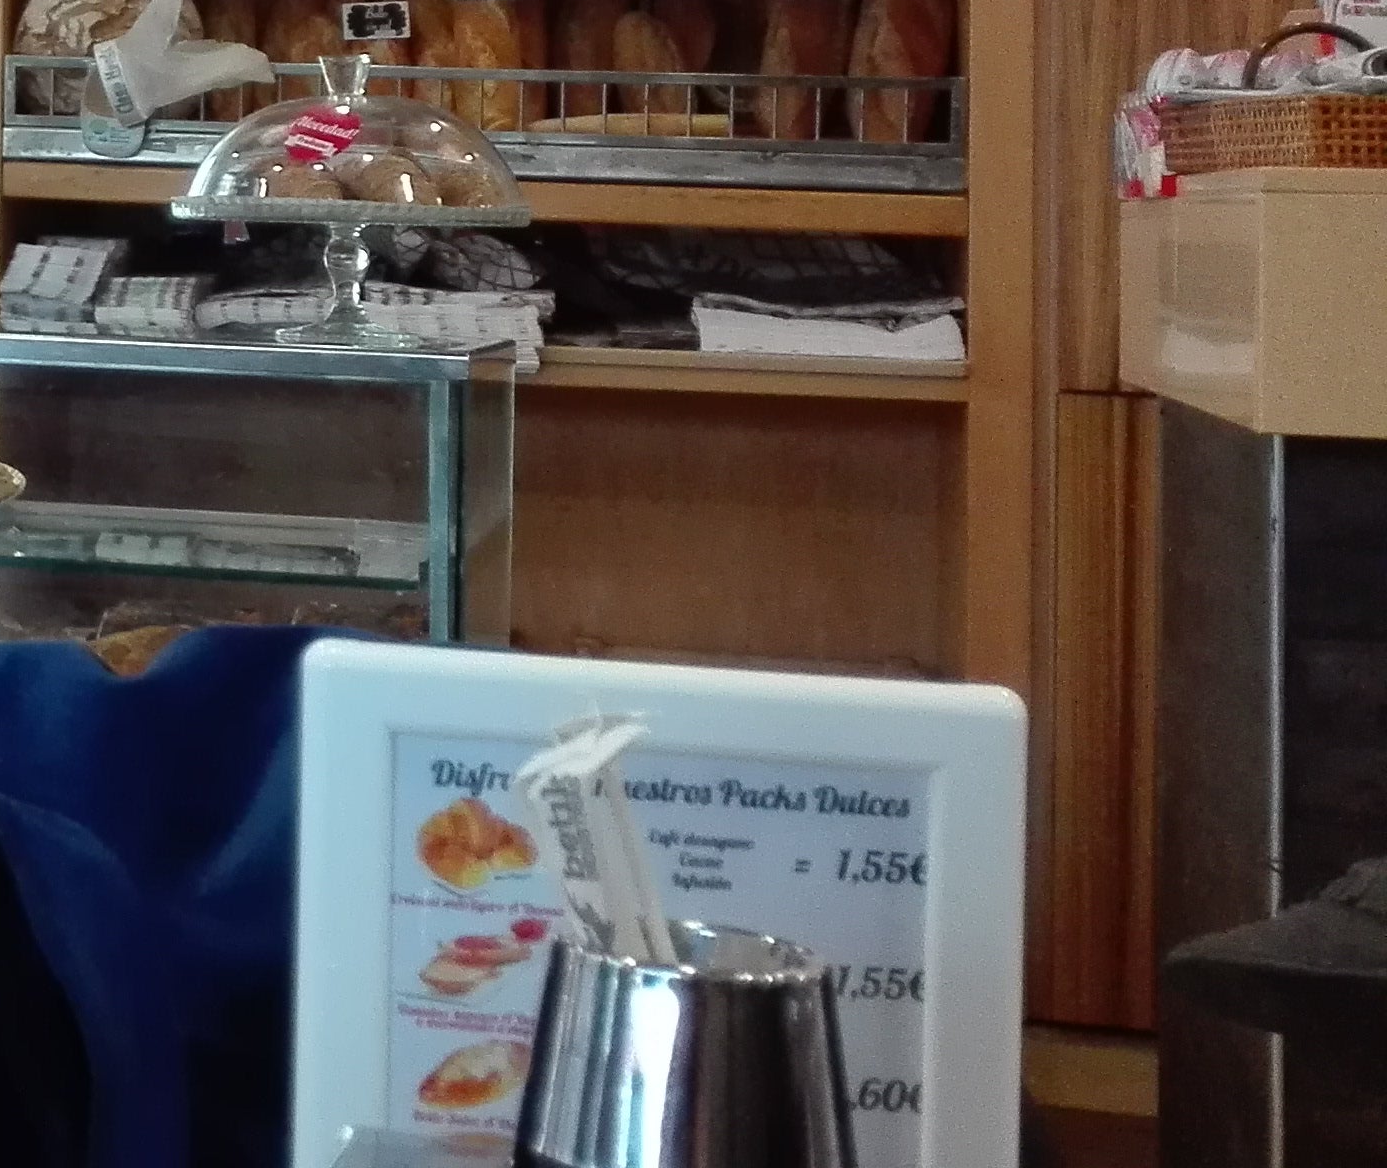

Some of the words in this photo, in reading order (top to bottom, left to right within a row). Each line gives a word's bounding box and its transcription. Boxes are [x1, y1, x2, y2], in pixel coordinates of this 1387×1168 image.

[621, 778, 712, 806] estros
[720, 779, 808, 812] Packs
[812, 785, 911, 818] Dulces
